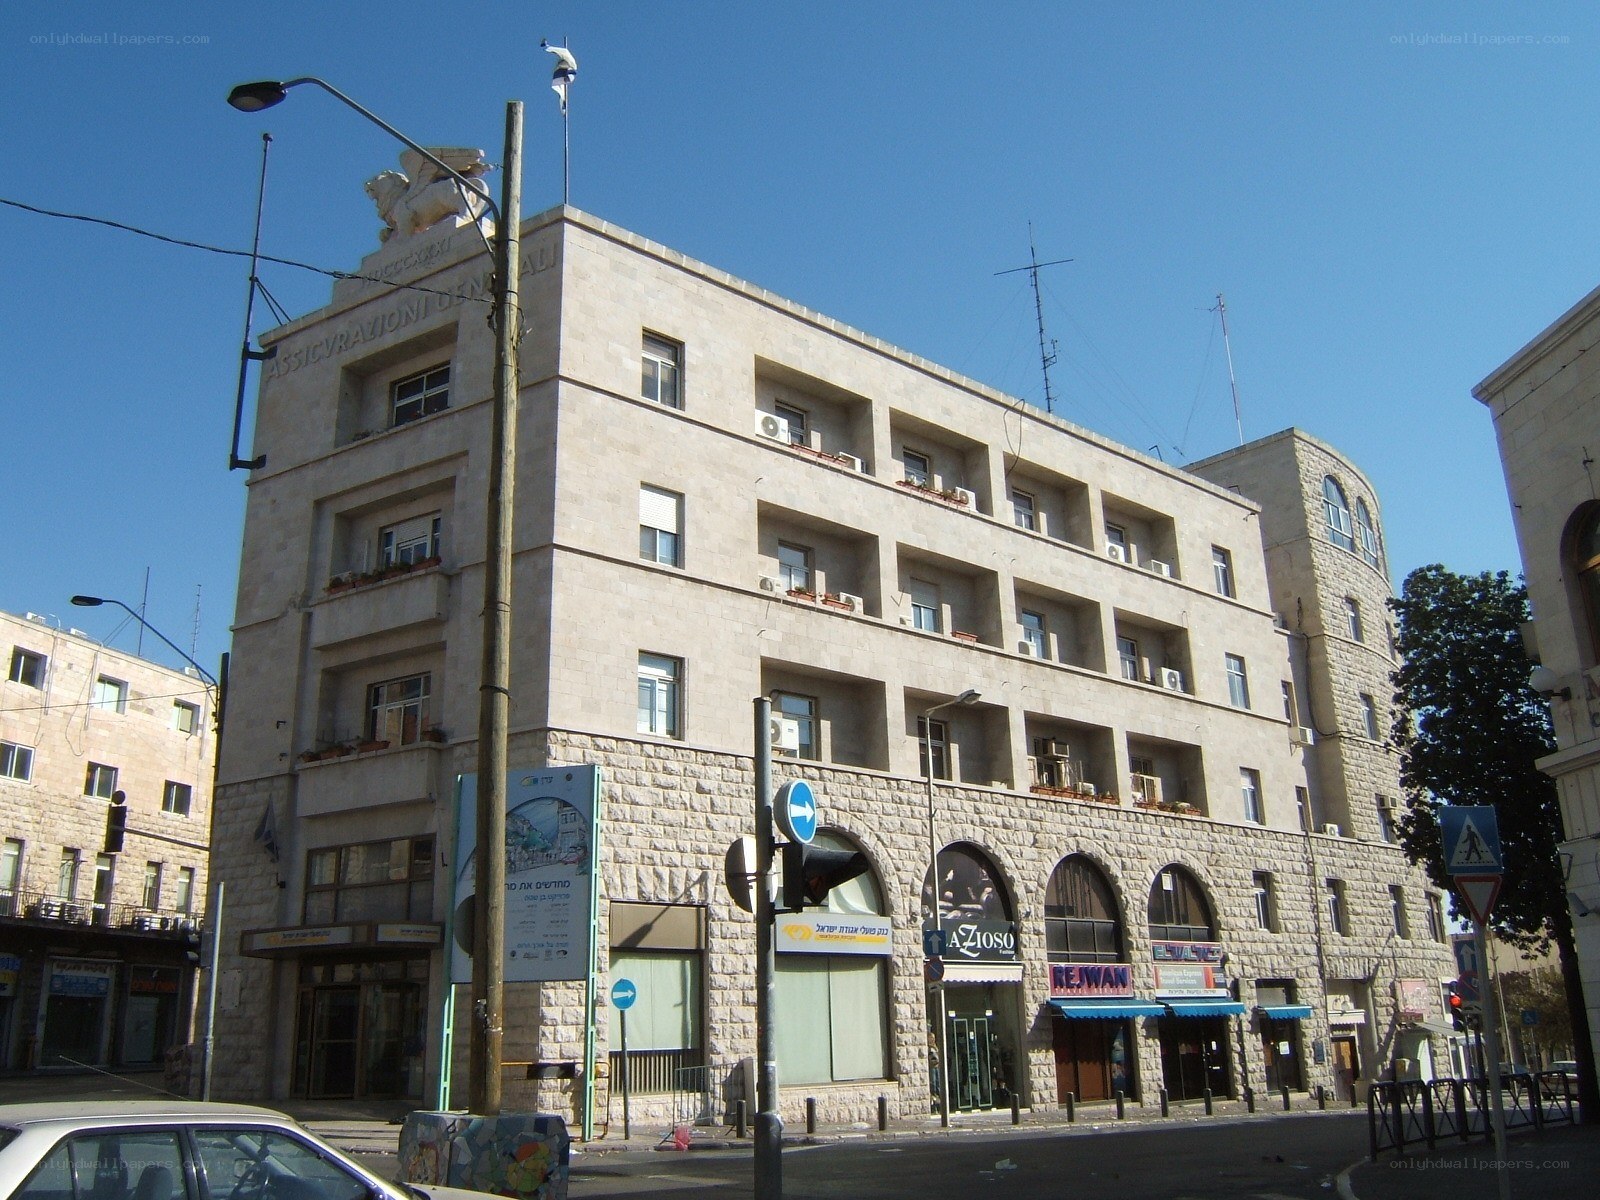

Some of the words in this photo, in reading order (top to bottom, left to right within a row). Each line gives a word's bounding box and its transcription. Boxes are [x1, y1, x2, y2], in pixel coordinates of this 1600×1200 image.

[438, 243, 558, 312] GENALI
[504, 882, 517, 891] מר
[519, 882, 533, 891] את
[535, 880, 571, 890] מחדשים
[815, 922, 838, 933] ישראל
[839, 925, 859, 934] אגודת
[860, 925, 876, 936] פועלי
[876, 927, 889, 936] בנק
[945, 923, 1015, 958] AZIOSO
[1052, 965, 1128, 989] REJWAN
